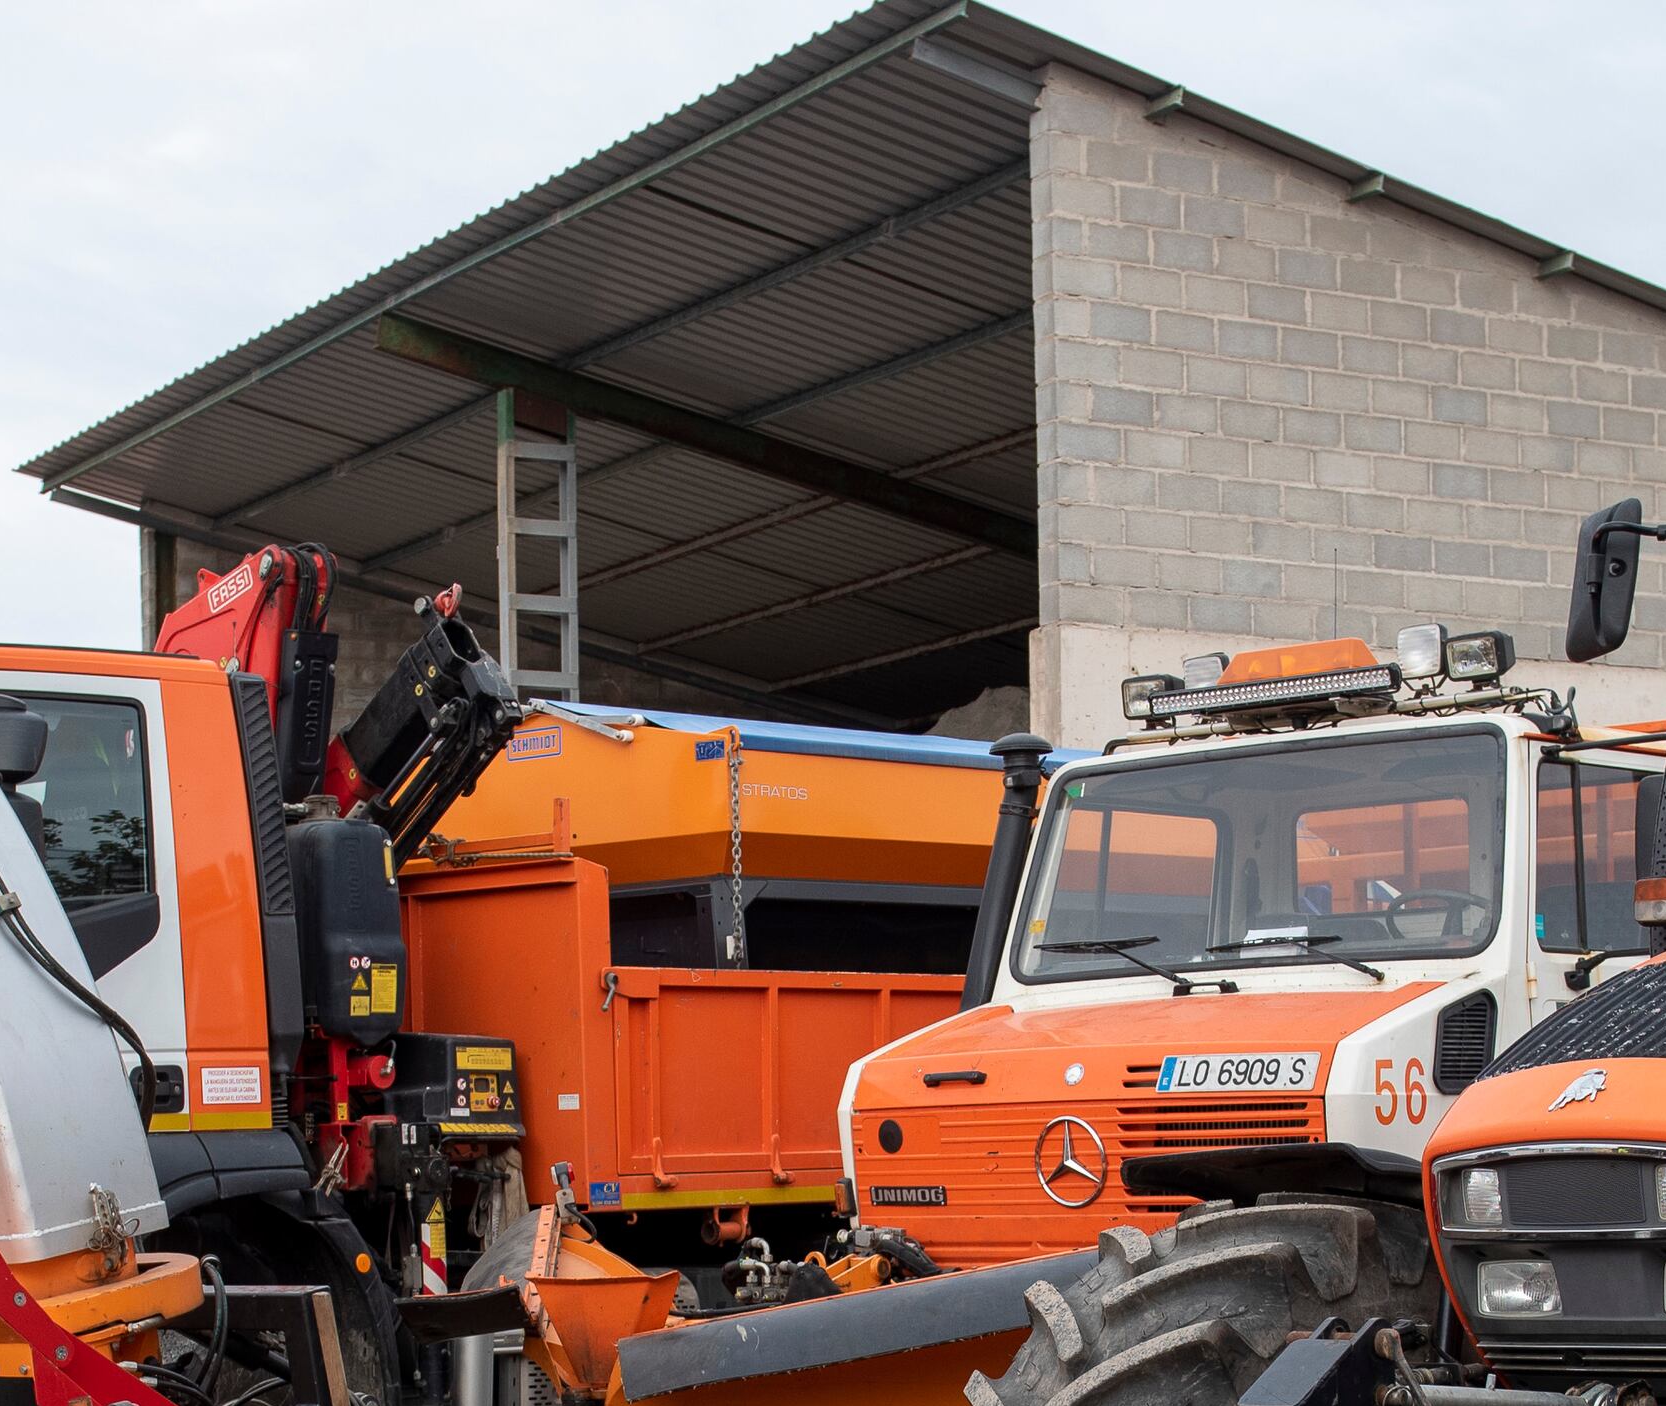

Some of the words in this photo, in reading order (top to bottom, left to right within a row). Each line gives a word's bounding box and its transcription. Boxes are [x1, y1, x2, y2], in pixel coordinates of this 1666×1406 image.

[210, 570, 250, 609] FASSI
[304, 659, 324, 758] FASSI
[511, 734, 558, 752] SCHMIDT
[741, 783, 808, 801] STRATOS
[1217, 1058, 1281, 1086] 6909
[1289, 1058, 1306, 1085] S
[1374, 1057, 1427, 1126] 56
[603, 1182, 619, 1193] CV
[871, 1188, 944, 1203] UNIMOG
